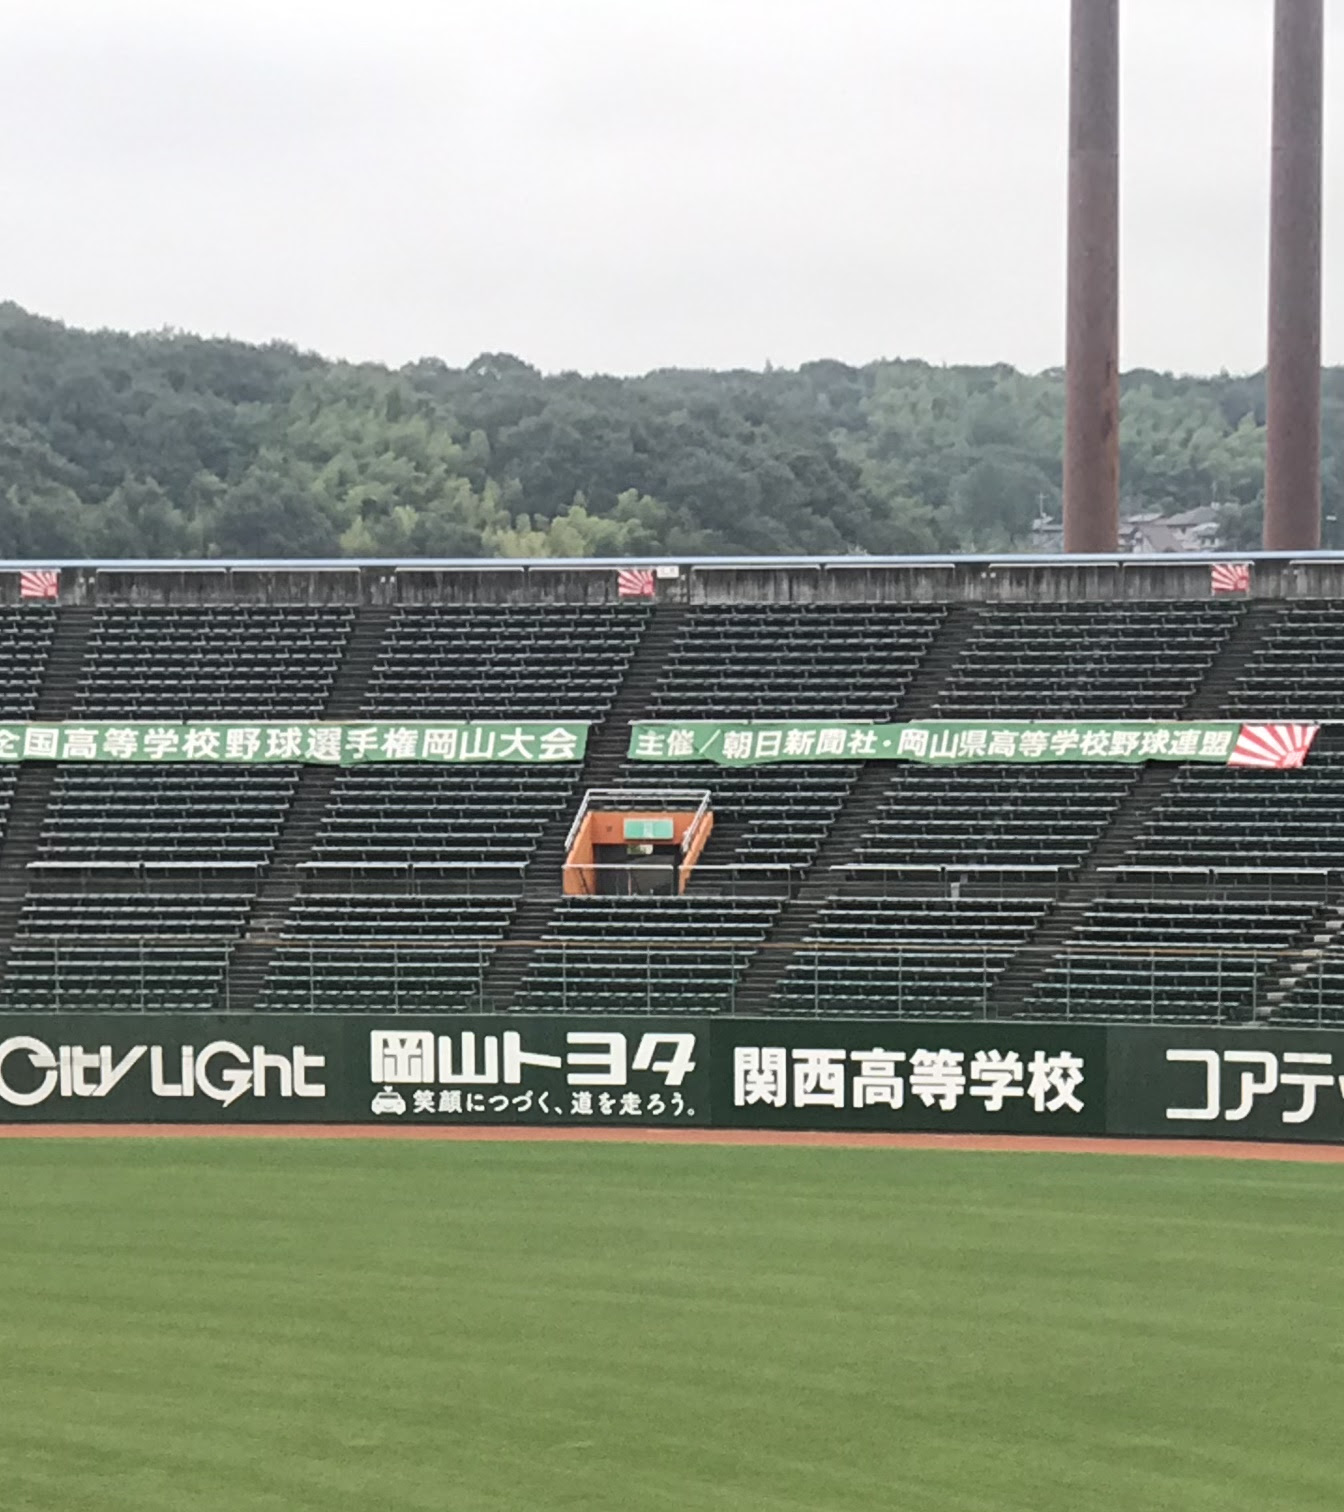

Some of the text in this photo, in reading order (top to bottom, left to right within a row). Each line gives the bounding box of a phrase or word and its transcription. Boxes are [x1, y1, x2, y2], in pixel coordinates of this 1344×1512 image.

[370, 1029, 697, 1086] 岡山トヨタ
[733, 1046, 1085, 1113] 関西高等学校
[412, 1089, 696, 1116] 笑顔につづく、道を走ろう。
